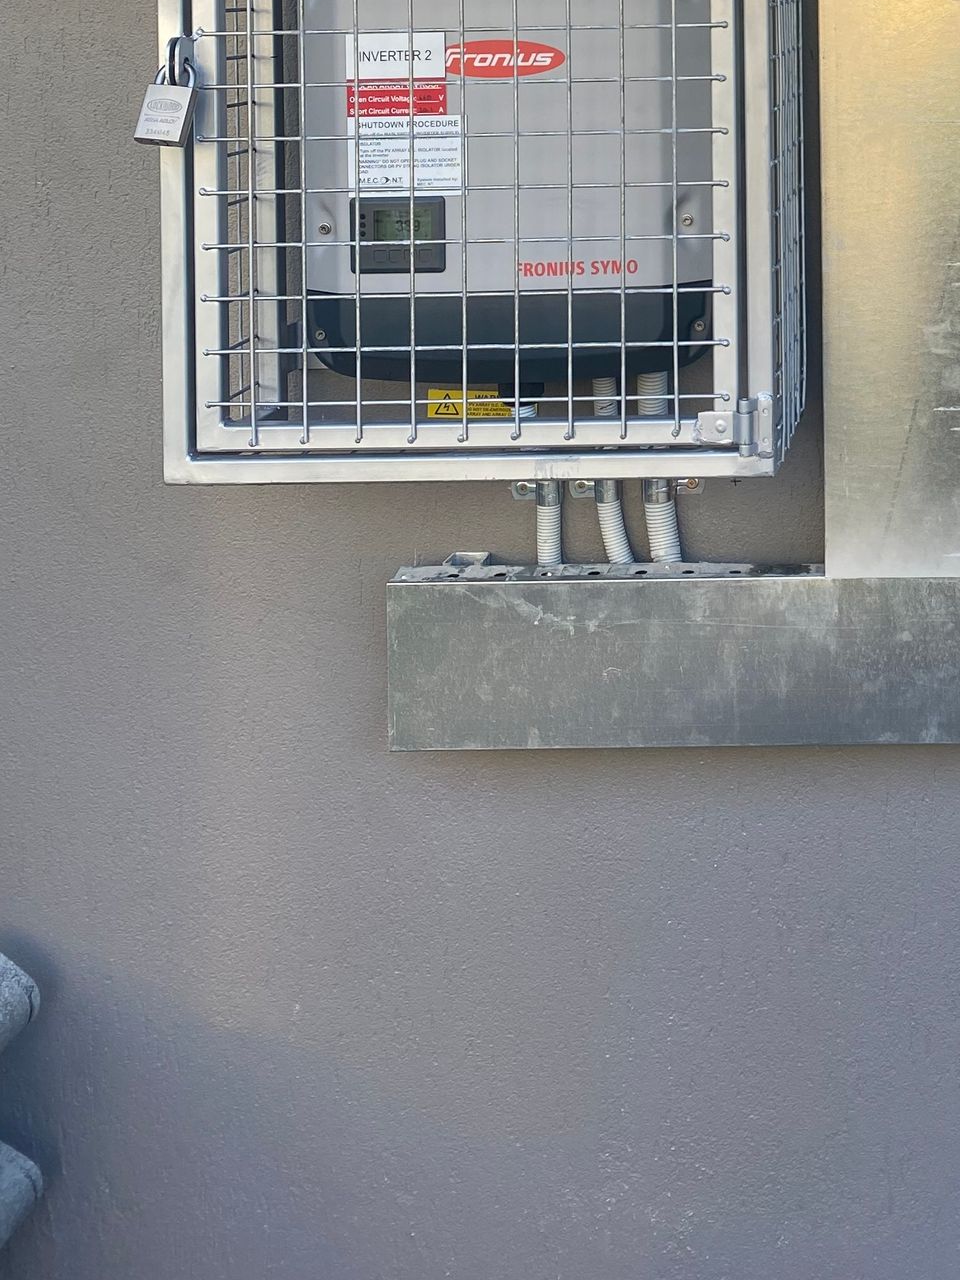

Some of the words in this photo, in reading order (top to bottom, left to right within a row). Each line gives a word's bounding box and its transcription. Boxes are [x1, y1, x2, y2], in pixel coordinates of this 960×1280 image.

[359, 50, 421, 62] INVERTER
[424, 49, 432, 61] 2
[349, 95, 367, 104] Oen
[368, 95, 389, 103] Circuit
[390, 95, 417, 104] Voltag:
[368, 107, 390, 115] Circuit
[390, 107, 417, 115] Curre:
